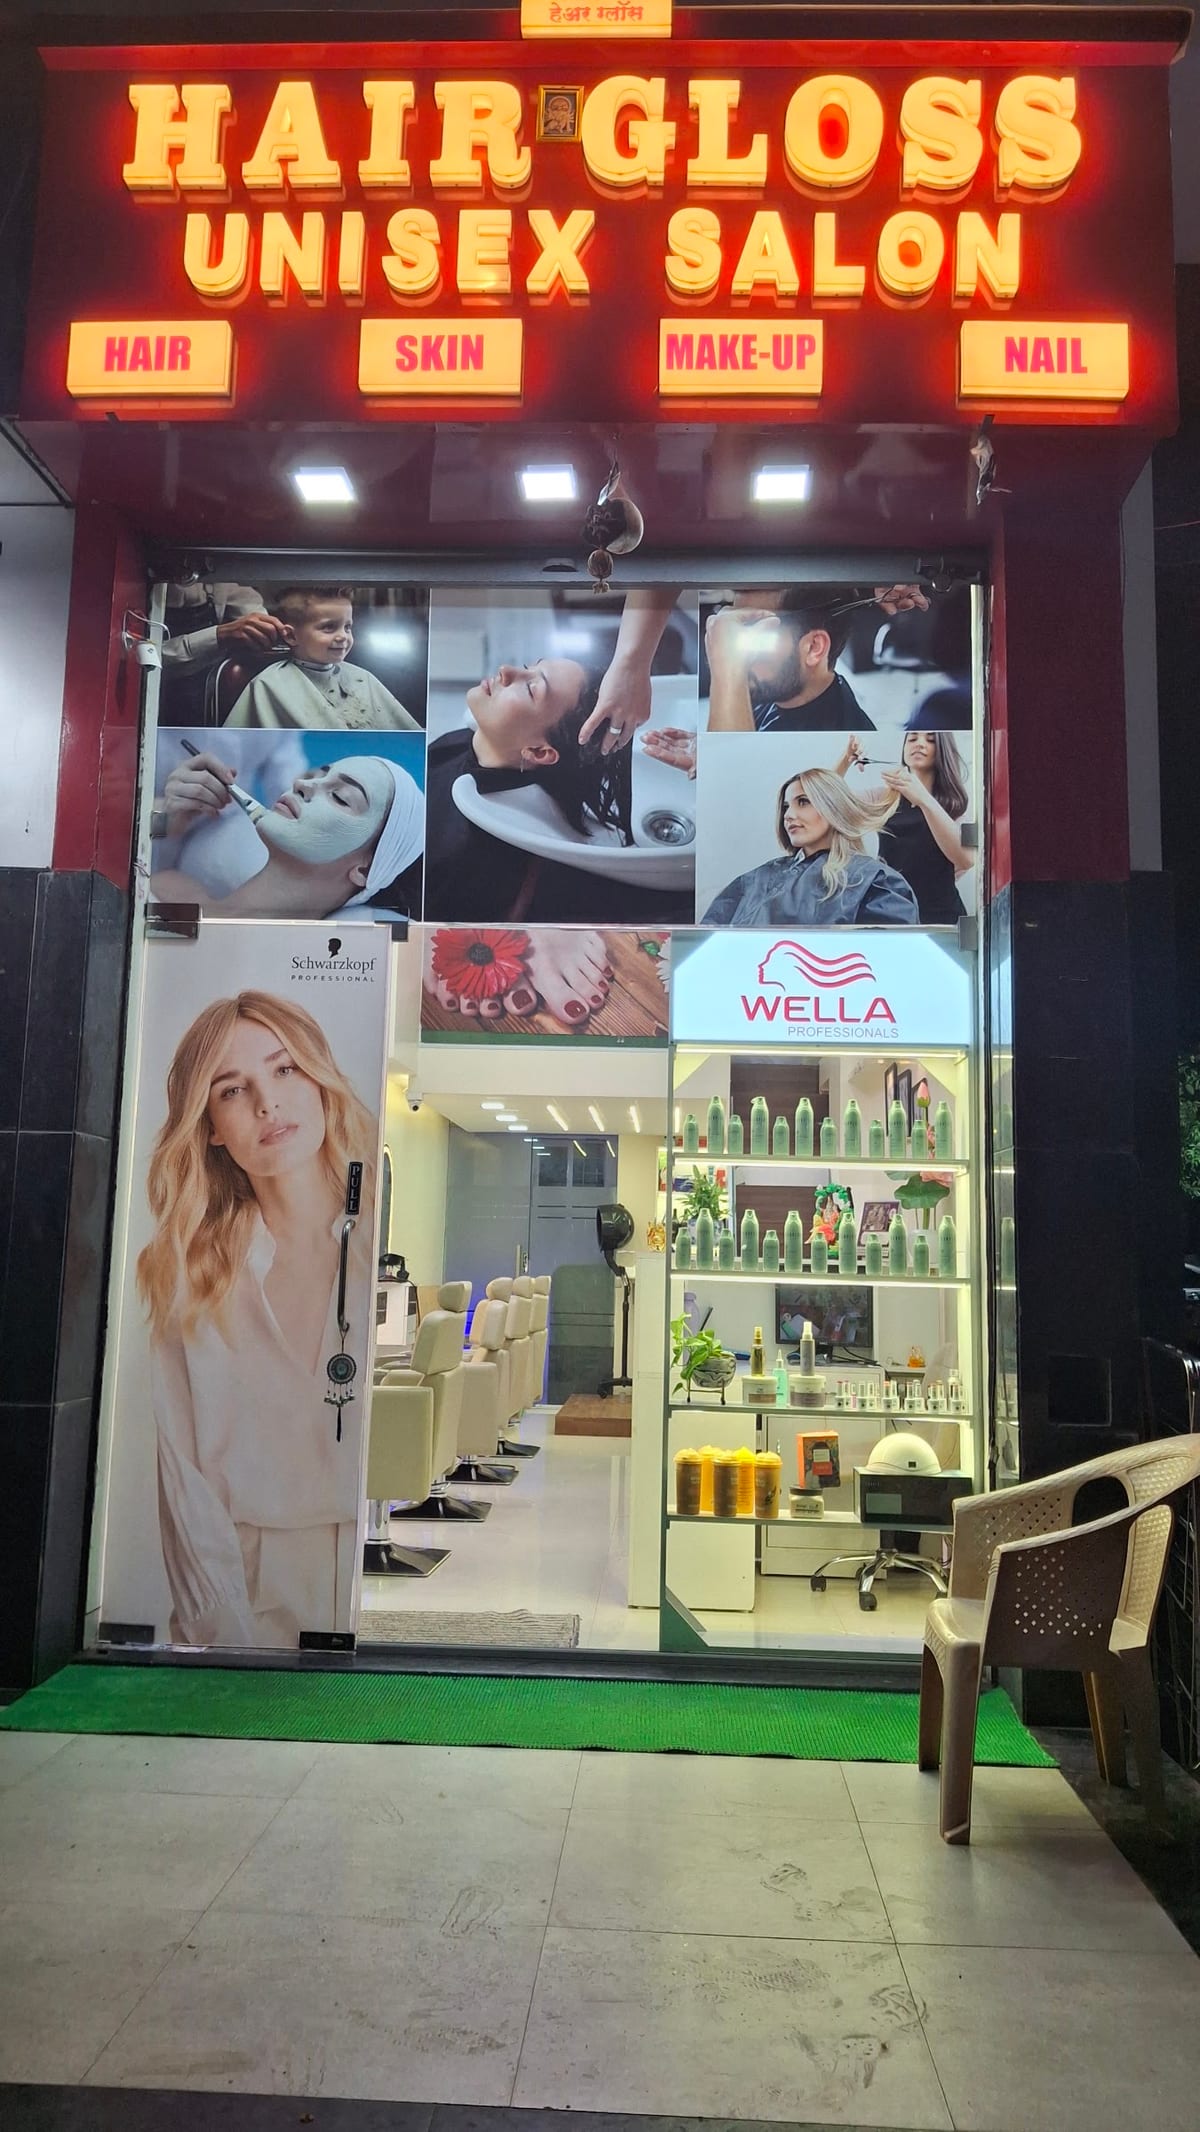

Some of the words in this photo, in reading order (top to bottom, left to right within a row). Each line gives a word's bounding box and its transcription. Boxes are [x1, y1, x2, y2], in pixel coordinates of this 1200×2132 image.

[549, 2, 591, 23] हेअर
[123, 80, 532, 190] HAIR
[582, 74, 1083, 191] GLOSS
[183, 208, 595, 296] UNISEX
[665, 207, 1021, 298] SALON
[104, 336, 191, 372] HAIR
[395, 334, 485, 372] SKIN
[665, 334, 817, 371] MAKE-UP
[1004, 336, 1088, 374] NAIL
[291, 956, 377, 974] Schwarzkopf
[740, 995, 897, 1023] WELLA
[788, 1026, 899, 1039] PROFESSIONALS
[350, 1165, 360, 1211] PULL
